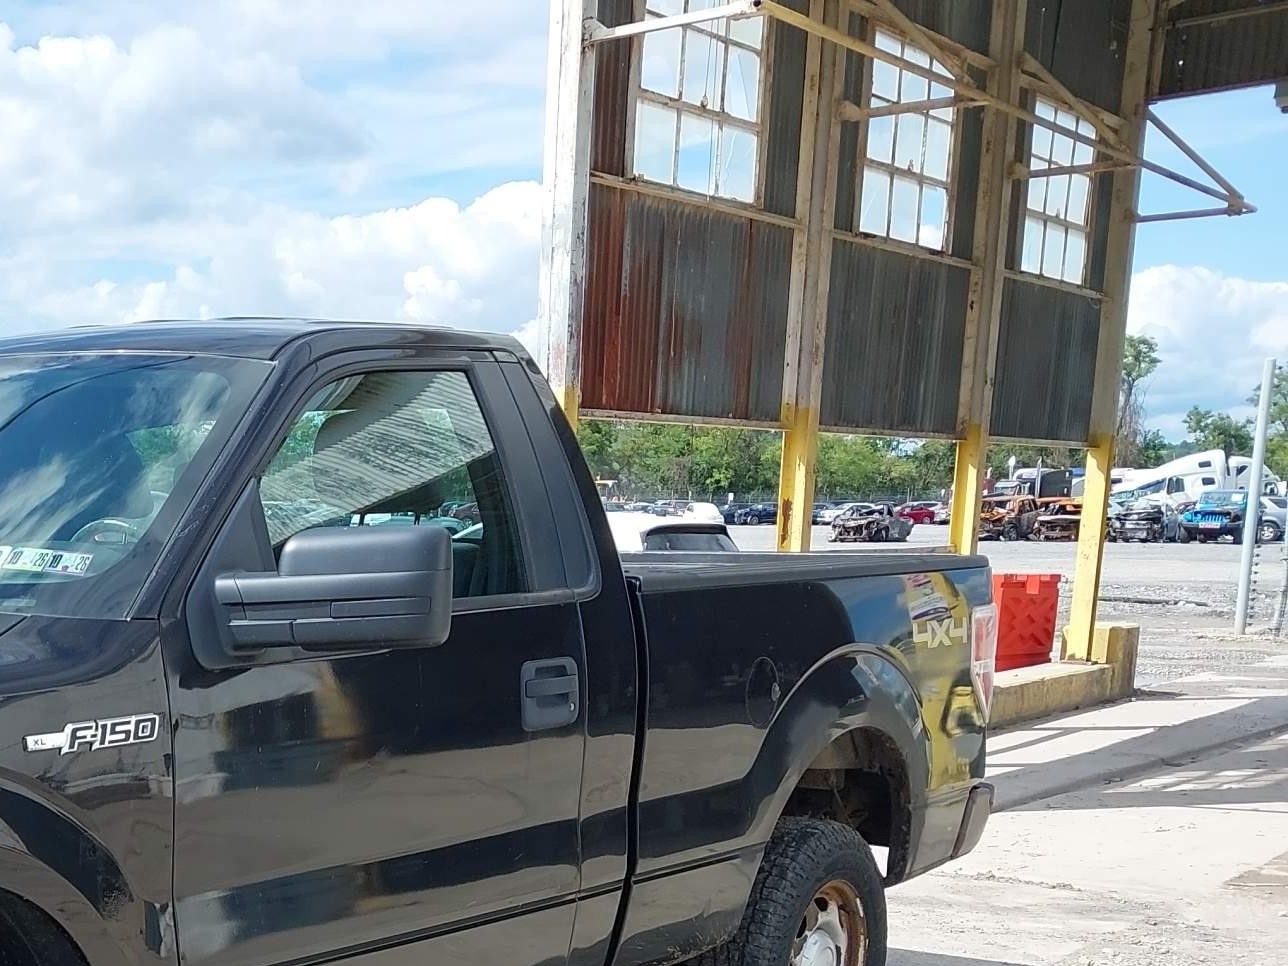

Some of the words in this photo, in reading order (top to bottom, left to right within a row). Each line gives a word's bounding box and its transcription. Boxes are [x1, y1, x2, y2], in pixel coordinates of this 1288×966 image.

[8, 550, 23, 565] 10
[48, 553, 63, 568] 10
[32, 738, 47, 746] XL
